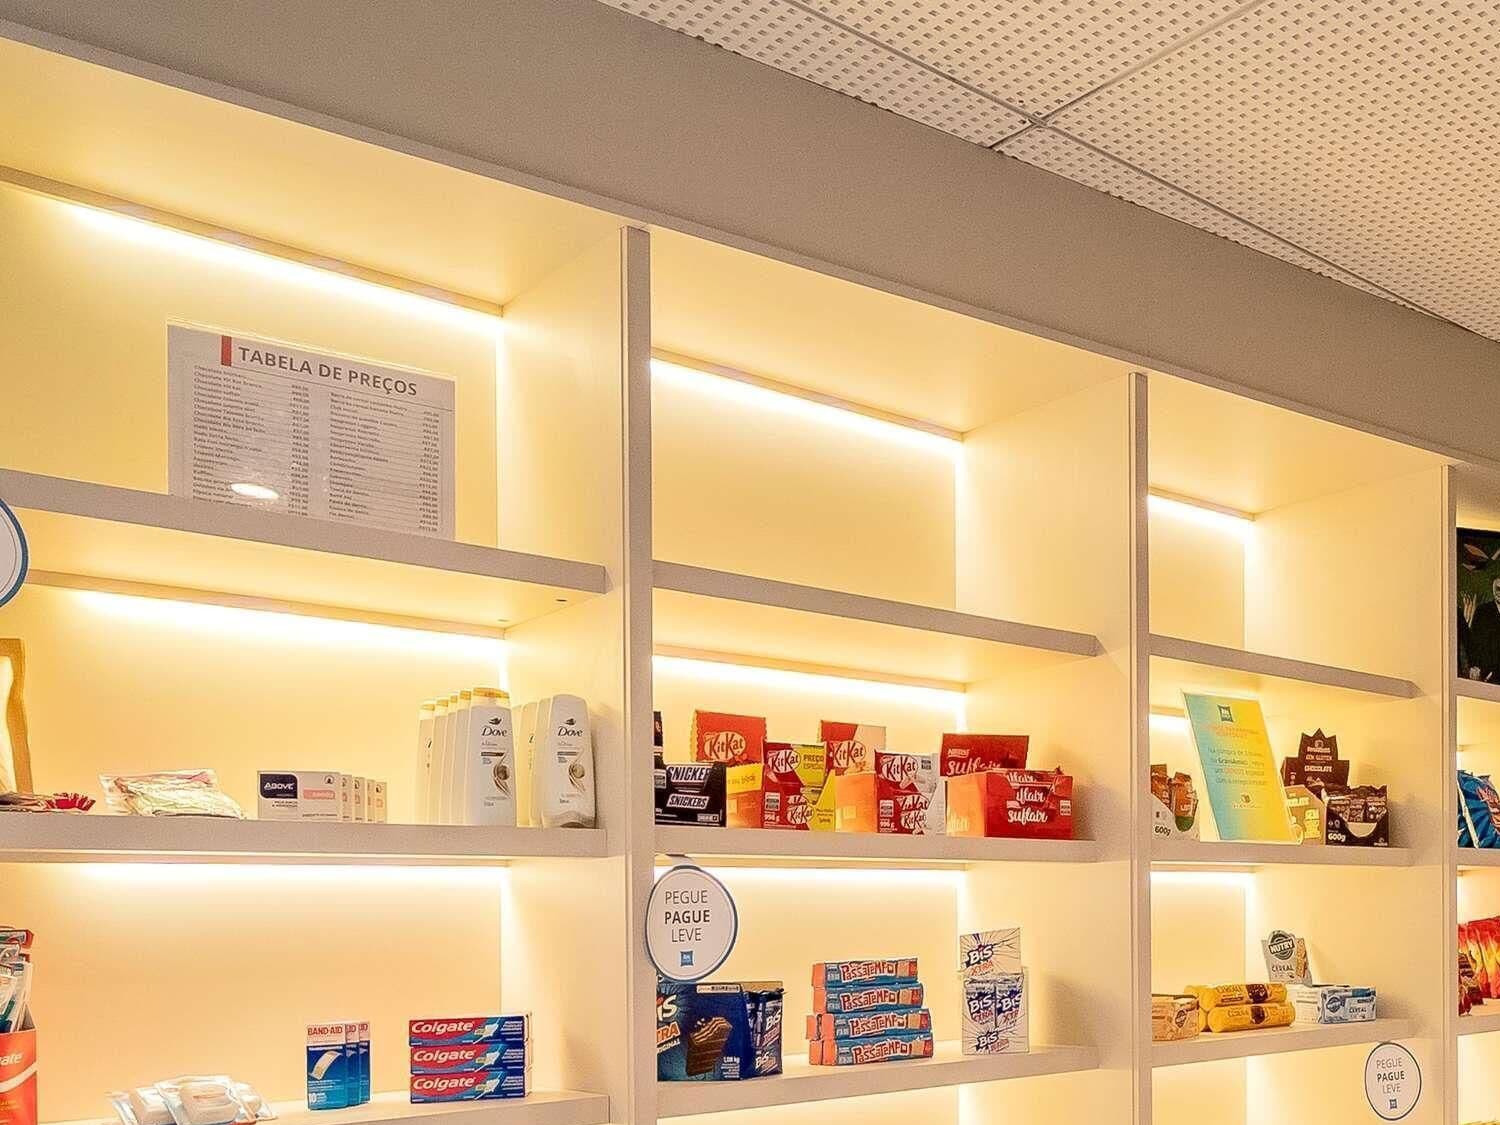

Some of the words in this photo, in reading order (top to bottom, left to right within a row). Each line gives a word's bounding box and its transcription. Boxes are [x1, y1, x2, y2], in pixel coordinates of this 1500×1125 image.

[238, 346, 313, 375] TABELA
[319, 364, 342, 381] DE
[348, 370, 417, 395] PREÇOS
[481, 727, 508, 737] Dove
[557, 726, 583, 737] Dove
[709, 733, 744, 760] KitKat
[771, 750, 799, 772] KitKat
[886, 756, 917, 781] KitKat
[1007, 806, 1048, 825] suflair
[1327, 832, 1347, 843] 600g
[665, 890, 708, 905] PEGUE
[664, 910, 711, 925] PAGUE
[671, 928, 702, 943] LEVE
[1269, 939, 1294, 954] NUTRY
[411, 1021, 474, 1035] Colgate
[413, 1049, 476, 1063] Colgate
[1376, 1057, 1403, 1069] PEGUE
[1376, 1070, 1405, 1082] PAGUE
[412, 1077, 475, 1091] Colgate
[1382, 1083, 1401, 1094] LEVE
